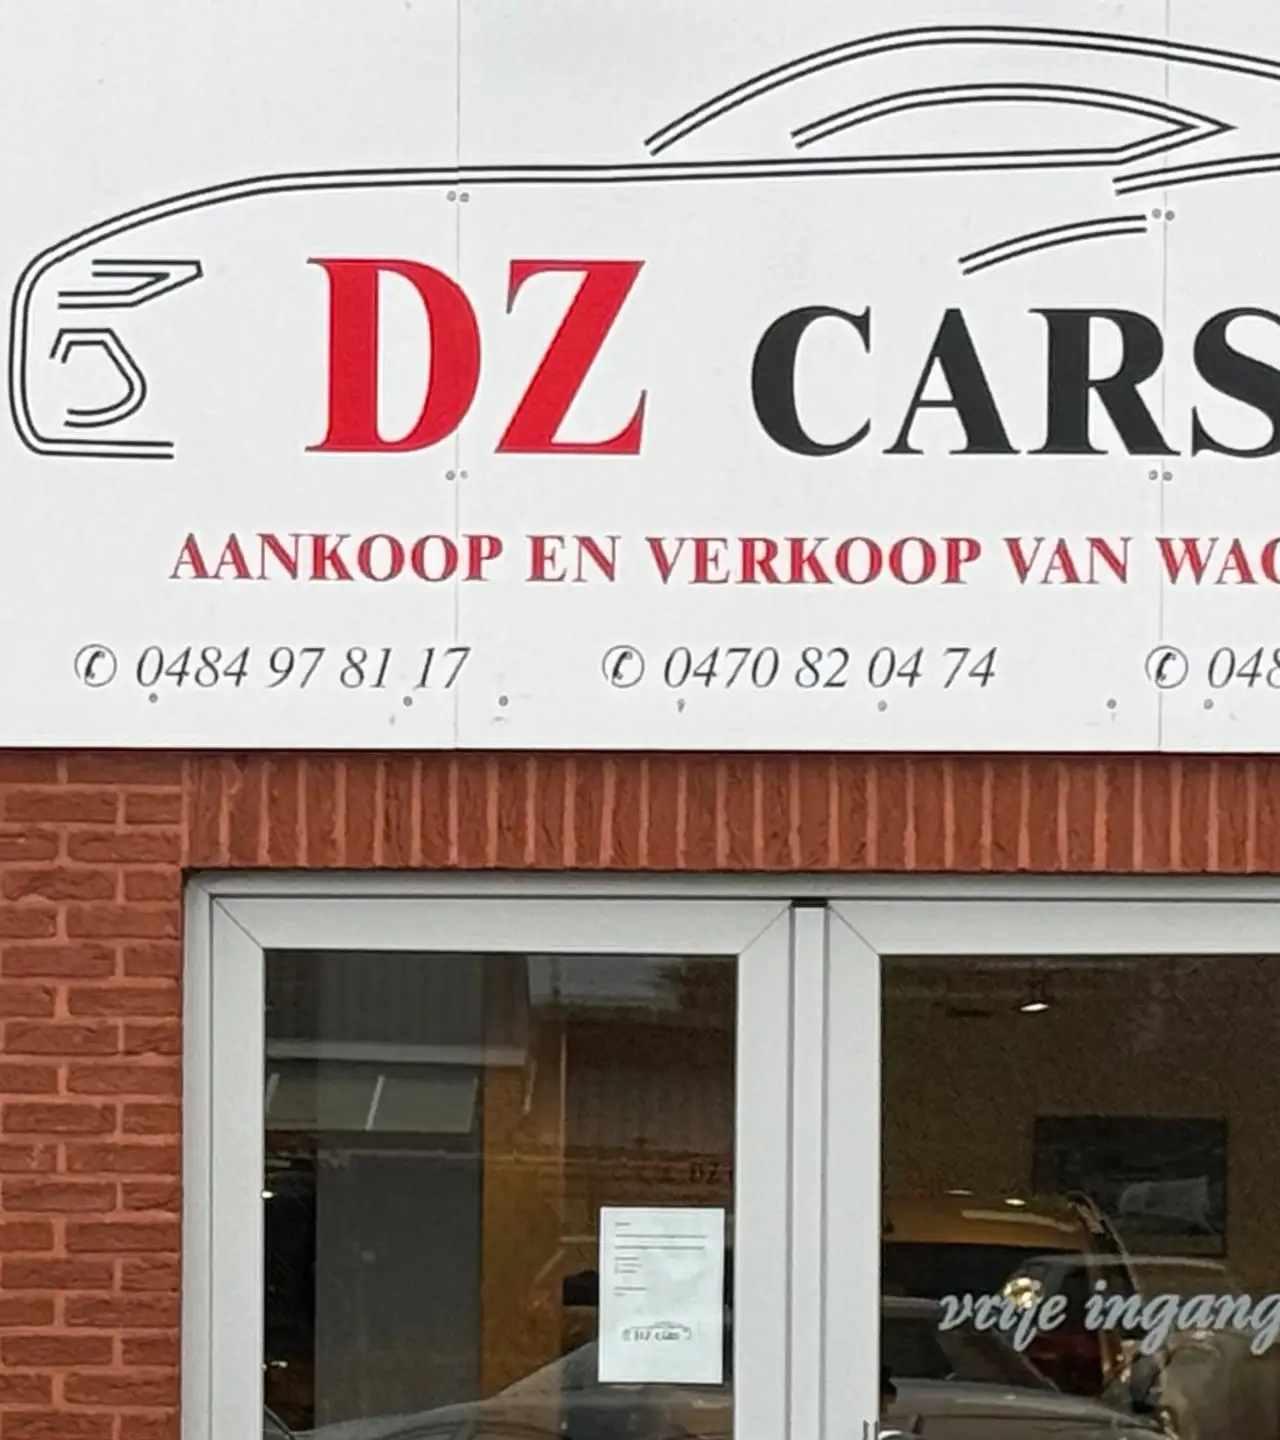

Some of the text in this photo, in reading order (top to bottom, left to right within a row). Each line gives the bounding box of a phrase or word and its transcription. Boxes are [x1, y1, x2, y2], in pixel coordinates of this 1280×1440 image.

[306, 258, 648, 457] DZ
[170, 533, 504, 583] AANKOOP
[527, 535, 618, 584] EN
[646, 536, 983, 585] VERKOOP
[1004, 537, 1133, 585] VAN
[136, 646, 472, 690] 0484 97 81 17
[664, 646, 999, 690] 0470 82 04 74
[938, 1288, 1068, 1351] vrije
